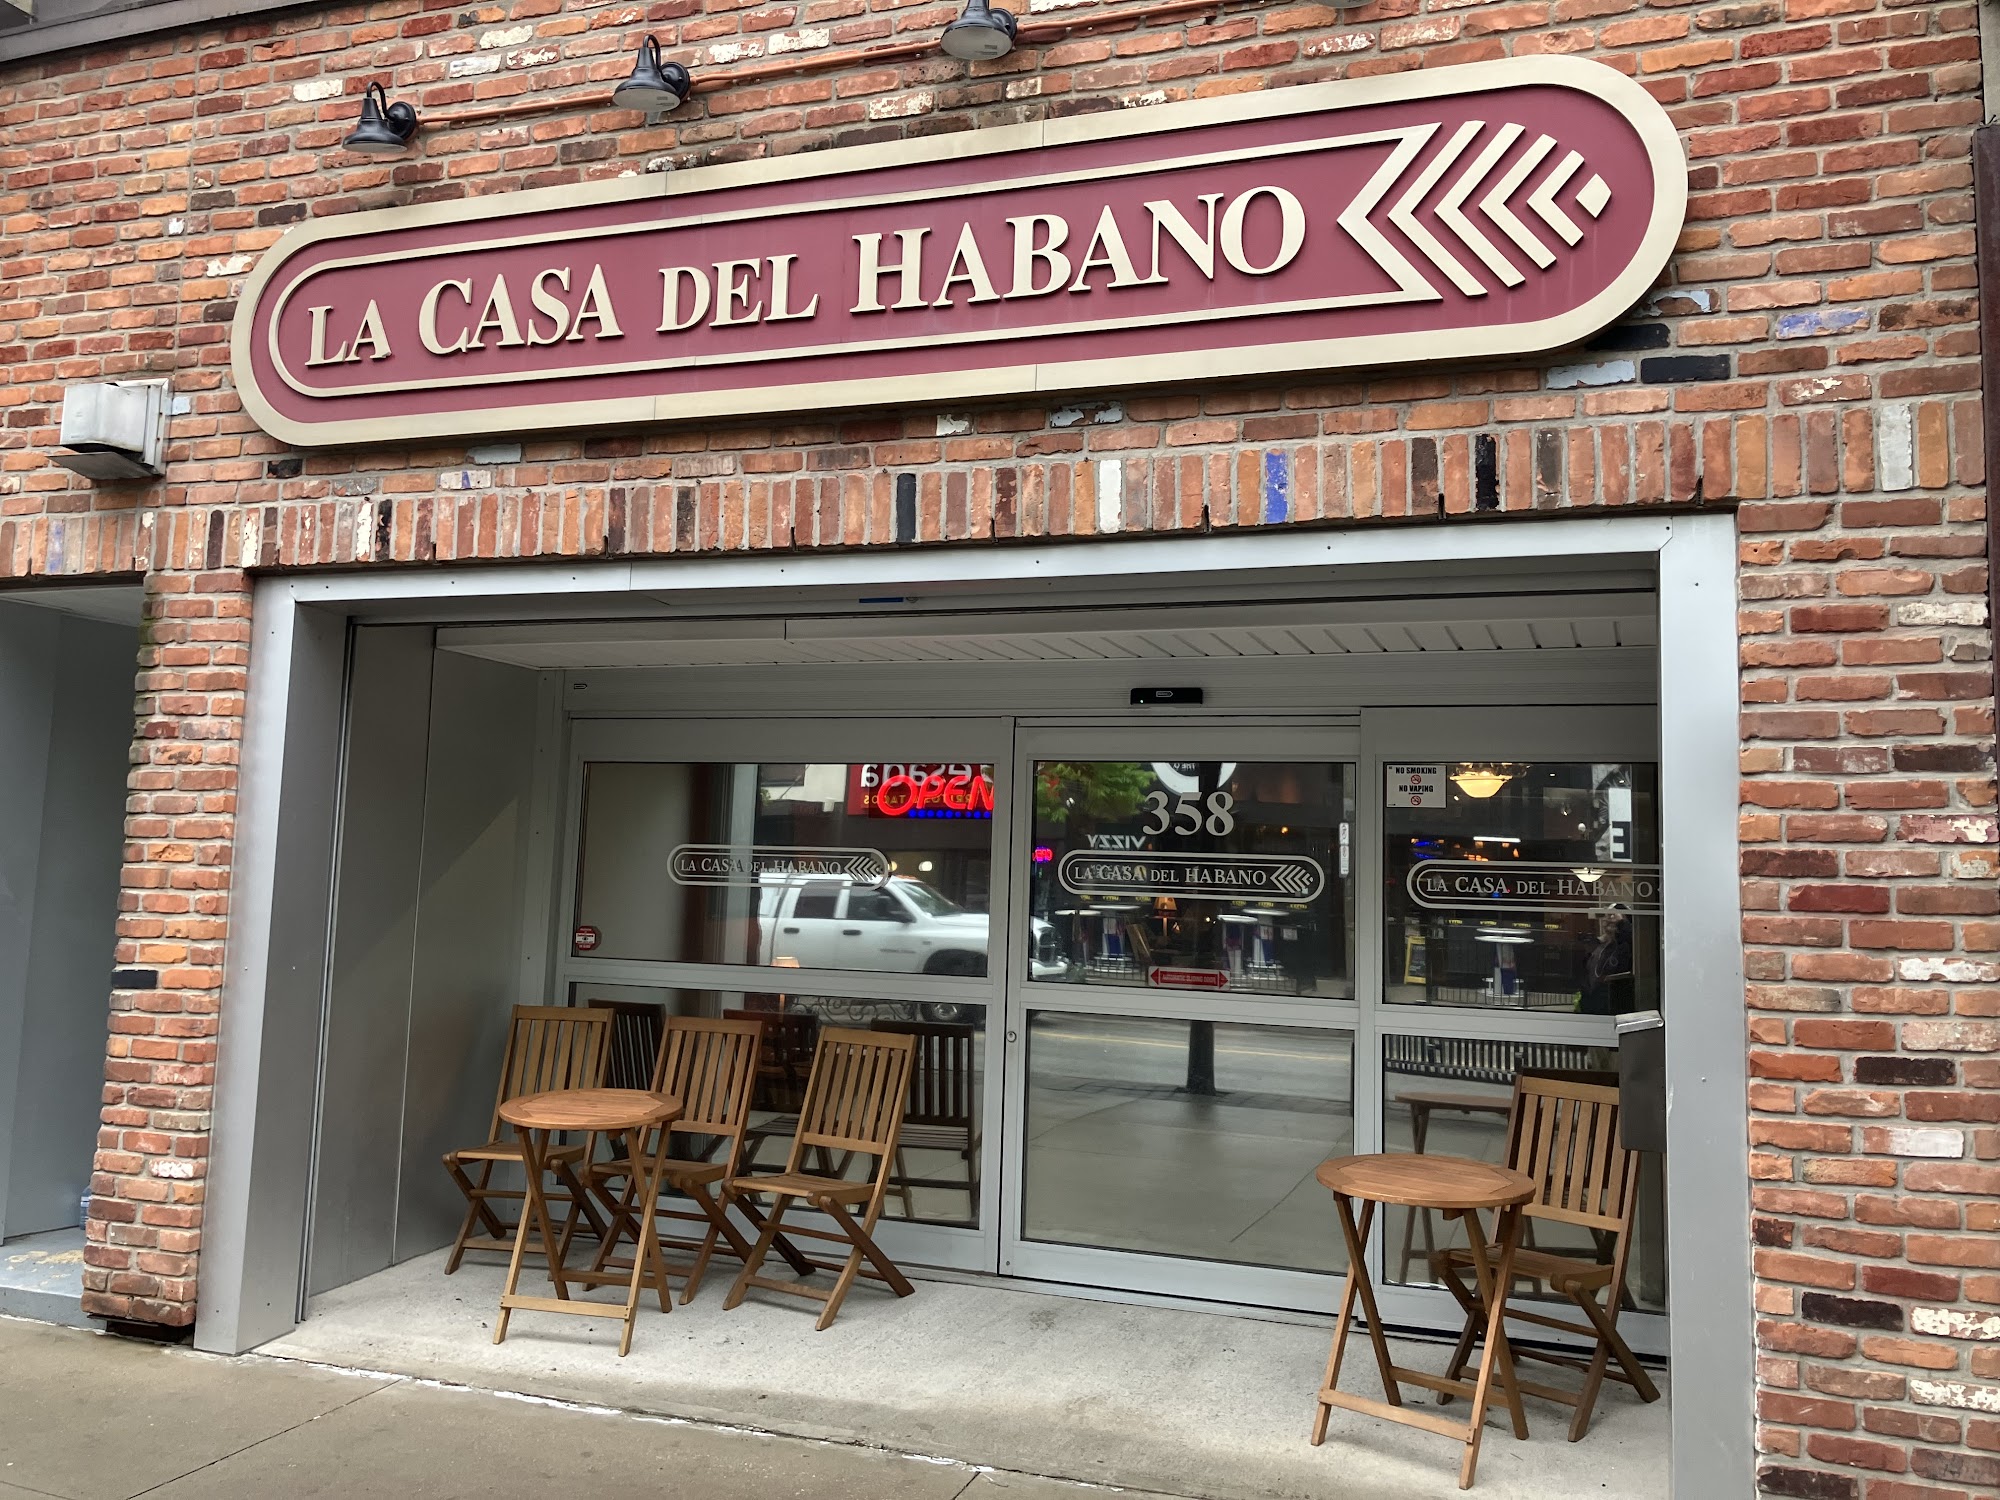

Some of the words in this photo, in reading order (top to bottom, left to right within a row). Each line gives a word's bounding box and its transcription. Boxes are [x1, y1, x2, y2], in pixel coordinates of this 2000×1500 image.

[303, 299, 392, 367] LA
[418, 263, 625, 356] CASA
[656, 253, 820, 333] DEL
[848, 184, 1307, 315] HABANO
[1395, 767, 1405, 775] NO
[1406, 767, 1437, 775] SMOKING
[877, 774, 994, 816] OPEN
[1398, 785, 1408, 793] NO
[1409, 785, 1434, 793] VAPING
[1142, 790, 1235, 836] 358
[680, 859, 697, 872] LA
[701, 857, 742, 873] CASA
[746, 861, 768, 874] DEL
[773, 860, 842, 875] HABANO
[1075, 866, 1094, 880] LA
[1099, 865, 1146, 882] CASA
[1150, 869, 1179, 883] DEL
[1184, 867, 1267, 886] HABANO
[1426, 878, 1449, 892] LA
[1455, 876, 1510, 894] CASA
[1516, 881, 1551, 895] DEL
[1557, 879, 1653, 898] HABANO
